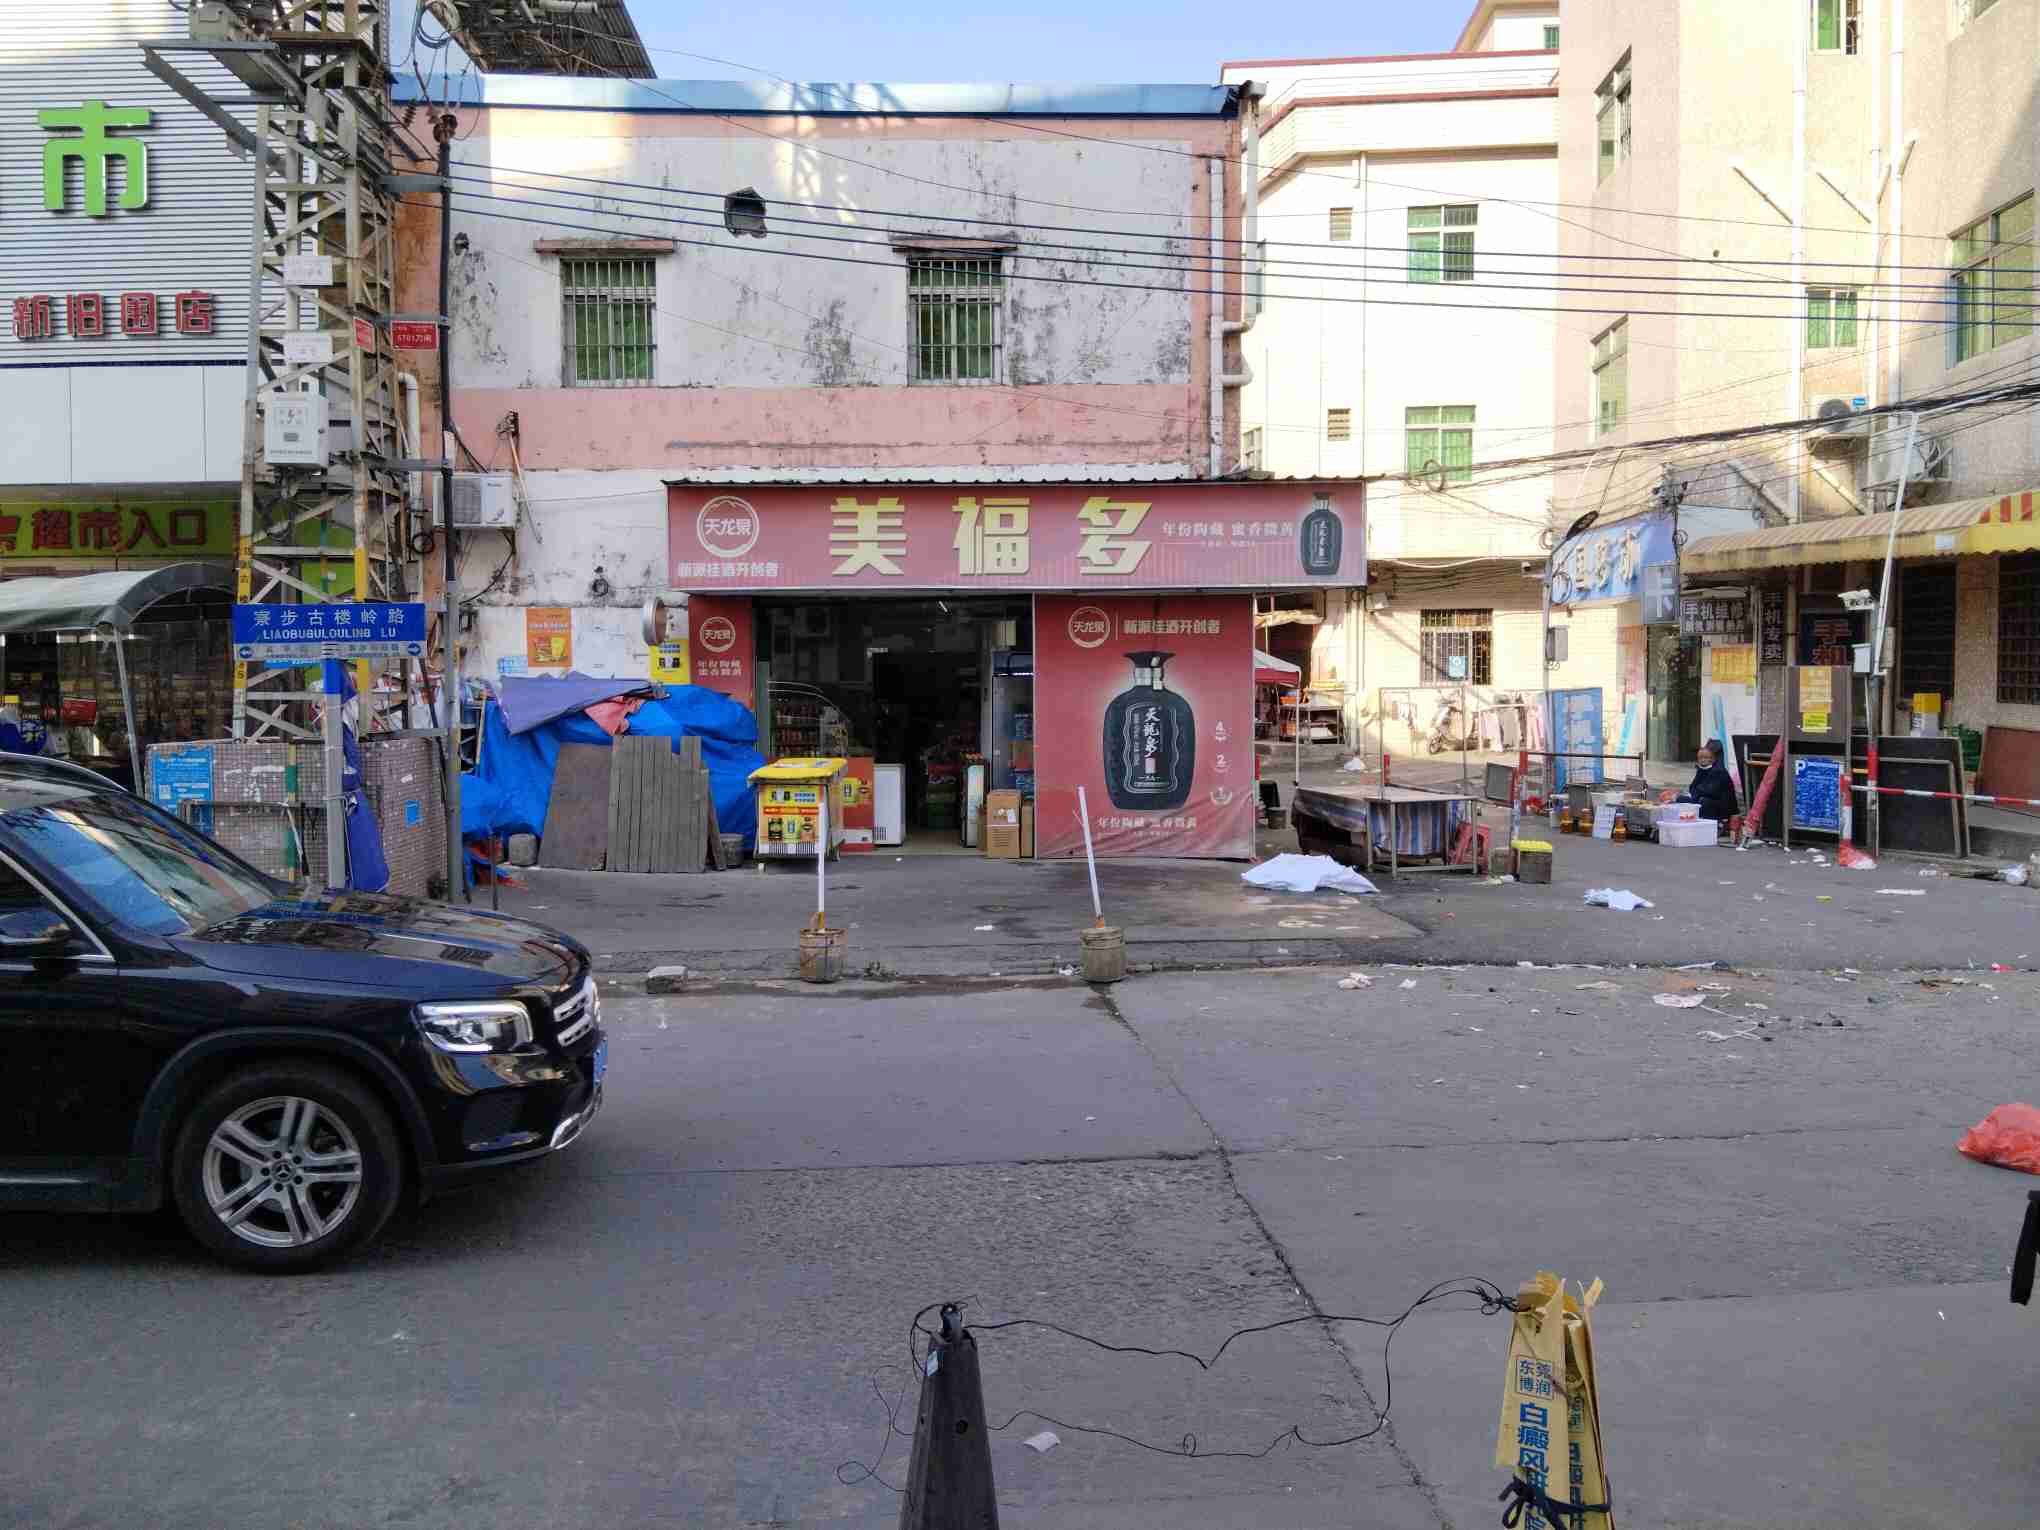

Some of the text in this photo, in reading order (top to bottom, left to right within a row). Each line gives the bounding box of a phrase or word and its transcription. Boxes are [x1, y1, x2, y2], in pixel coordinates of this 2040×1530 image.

[37, 100, 152, 218] 市
[828, 496, 1153, 576] 美福多
[381, 627, 397, 638] LU
